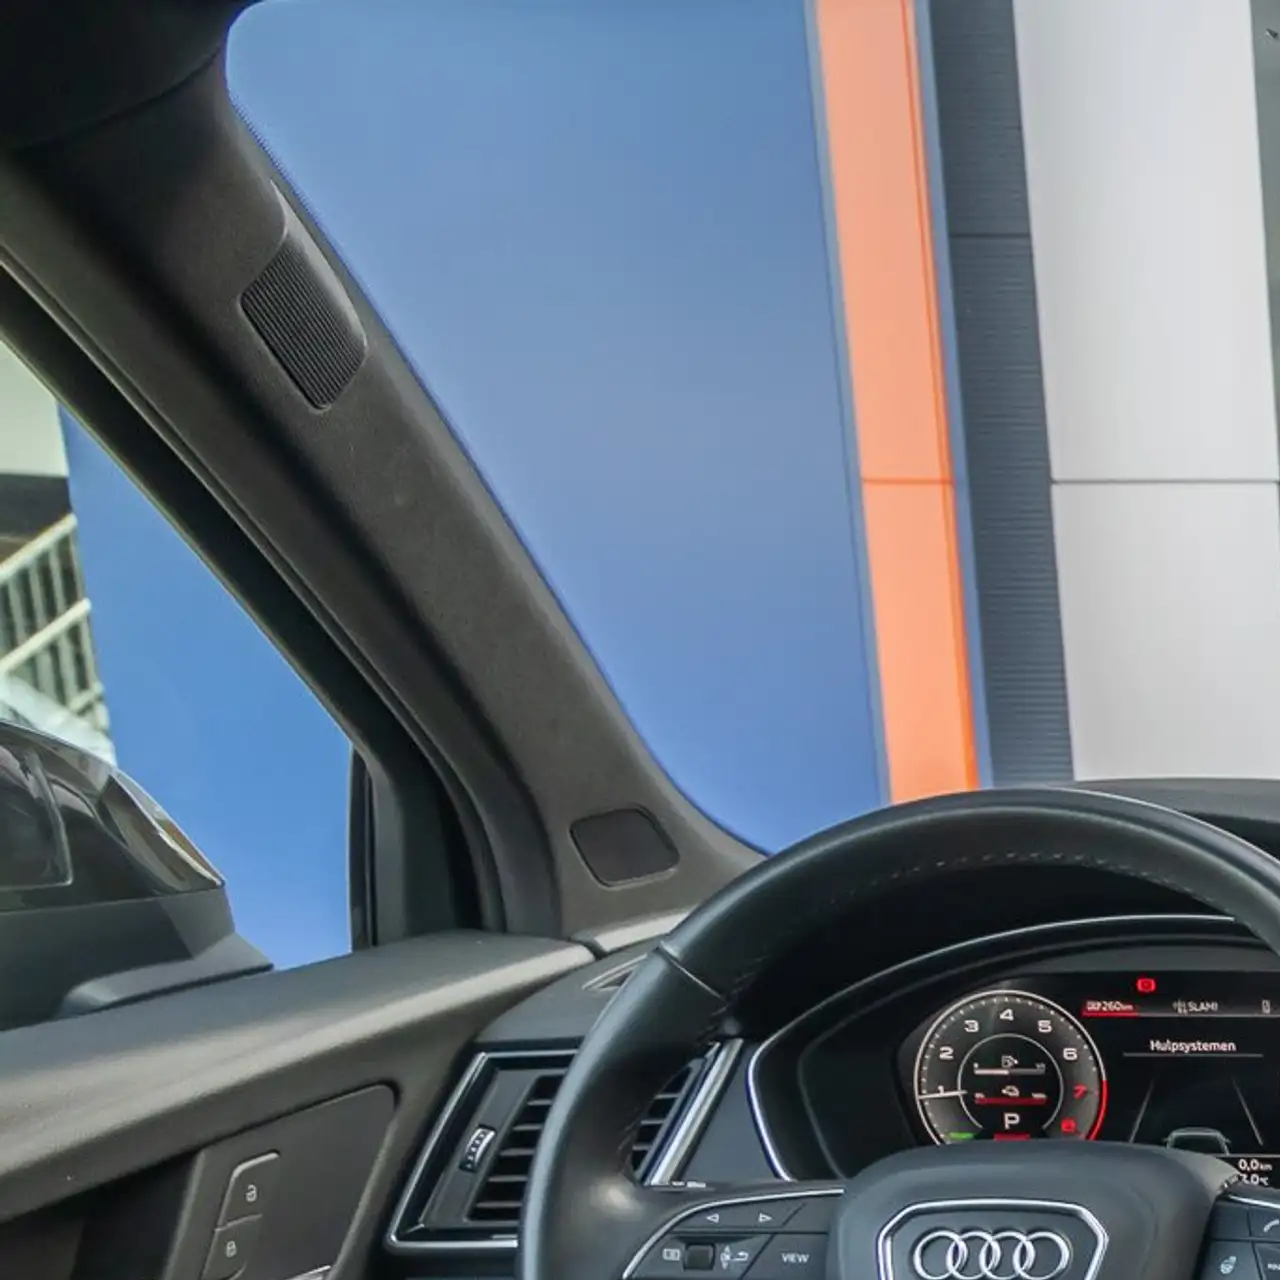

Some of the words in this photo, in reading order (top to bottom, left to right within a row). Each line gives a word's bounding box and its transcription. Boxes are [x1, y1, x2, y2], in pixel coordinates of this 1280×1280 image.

[999, 1008, 1014, 1021] 4
[964, 1020, 979, 1033] 3
[1038, 1020, 1052, 1033] 5
[1150, 1040, 1236, 1052] Hulpsystemen
[939, 1046, 954, 1060] 2
[1063, 1048, 1078, 1060] 6
[1073, 1085, 1088, 1099] 7
[1004, 1112, 1020, 1129] P
[782, 1252, 810, 1263] VIEW
